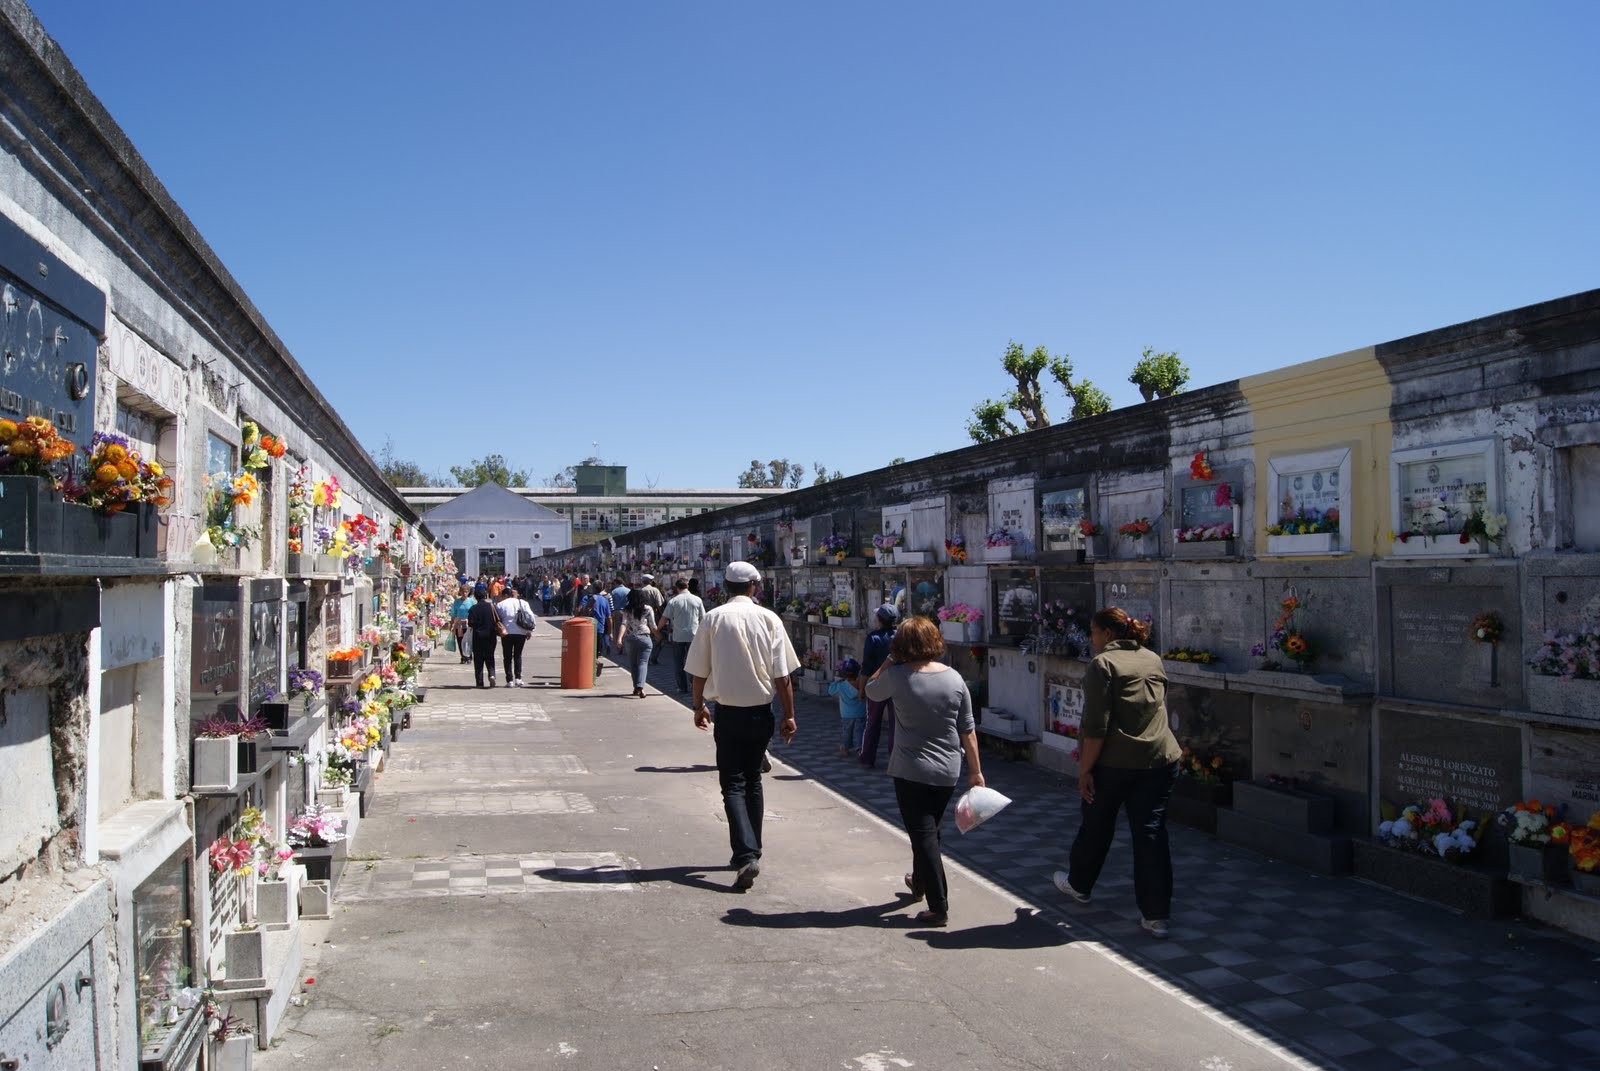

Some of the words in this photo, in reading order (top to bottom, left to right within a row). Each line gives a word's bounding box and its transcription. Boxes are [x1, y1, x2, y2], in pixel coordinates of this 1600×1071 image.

[1400, 753, 1433, 767] ALESSIO
[1443, 760, 1496, 778] LORENZATO
[1452, 784, 1500, 803] LORENZATO
